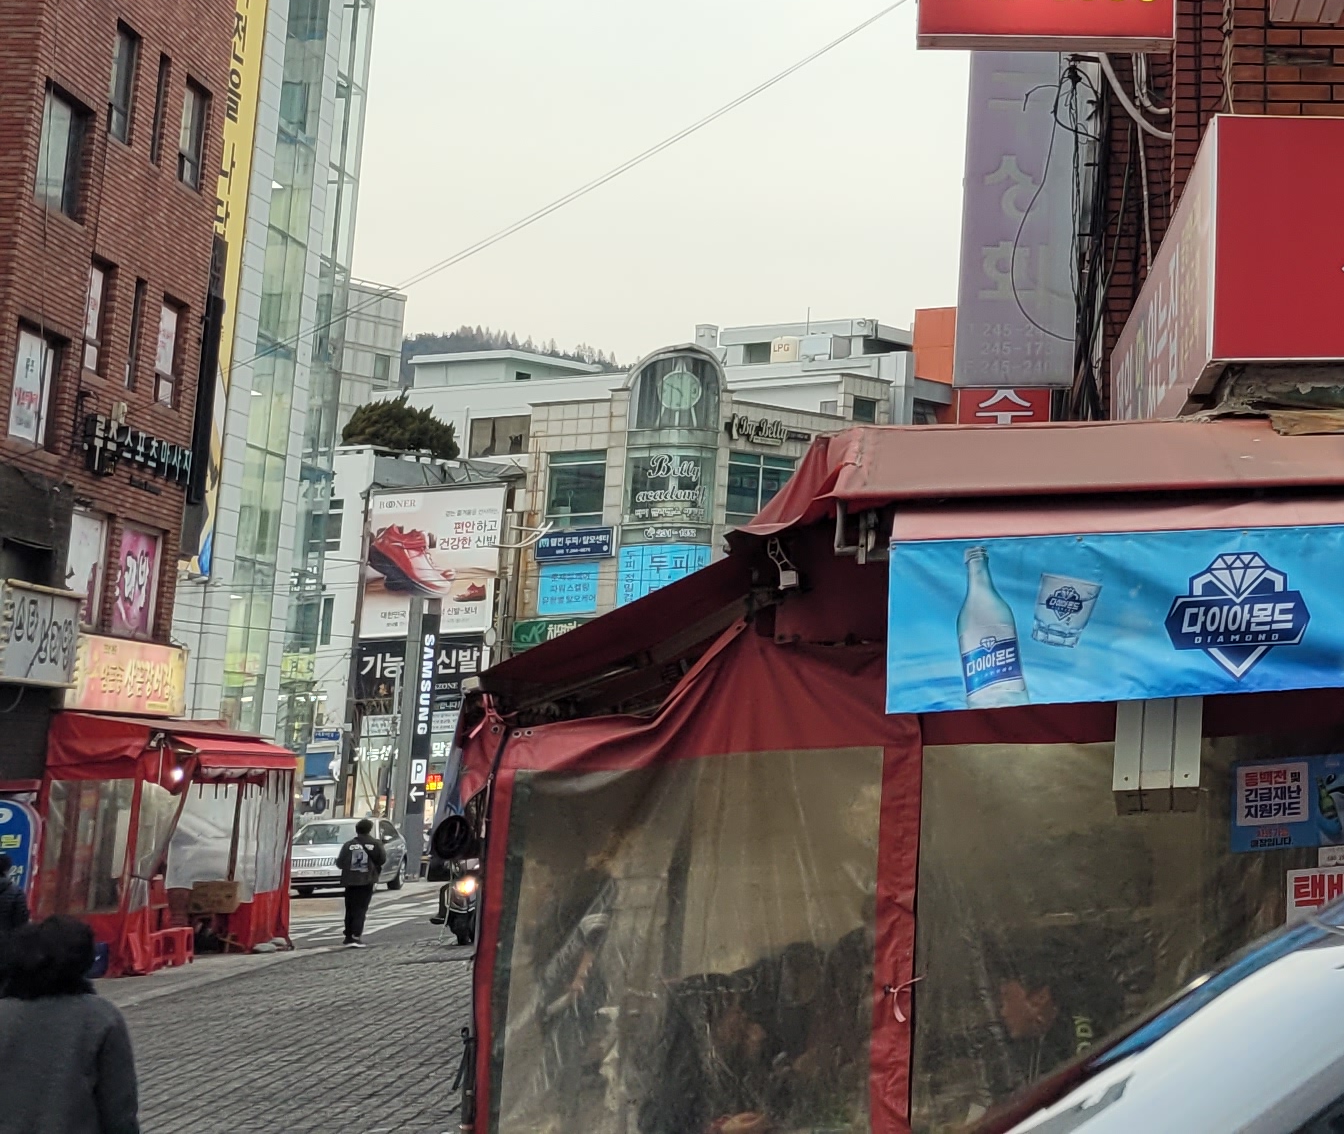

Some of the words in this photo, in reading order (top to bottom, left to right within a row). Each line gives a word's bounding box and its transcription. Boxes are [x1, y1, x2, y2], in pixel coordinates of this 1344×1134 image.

[773, 344, 790, 353] LPG
[759, 417, 788, 443] Belly
[453, 520, 498, 534] 편안하고
[439, 537, 472, 550] 건강한
[1181, 601, 1297, 635] 다이아몬드
[1194, 633, 1280, 645] DIAMOND
[437, 647, 480, 675] 신발
[965, 646, 1016, 677] 다이아몬드
[417, 633, 436, 735] SAMSUNG
[415, 762, 423, 780] P
[1245, 769, 1287, 787] 동백전
[1290, 771, 1301, 783] 및
[1244, 784, 1302, 804] 긴급재난
[1244, 802, 1302, 819] 지원카드
